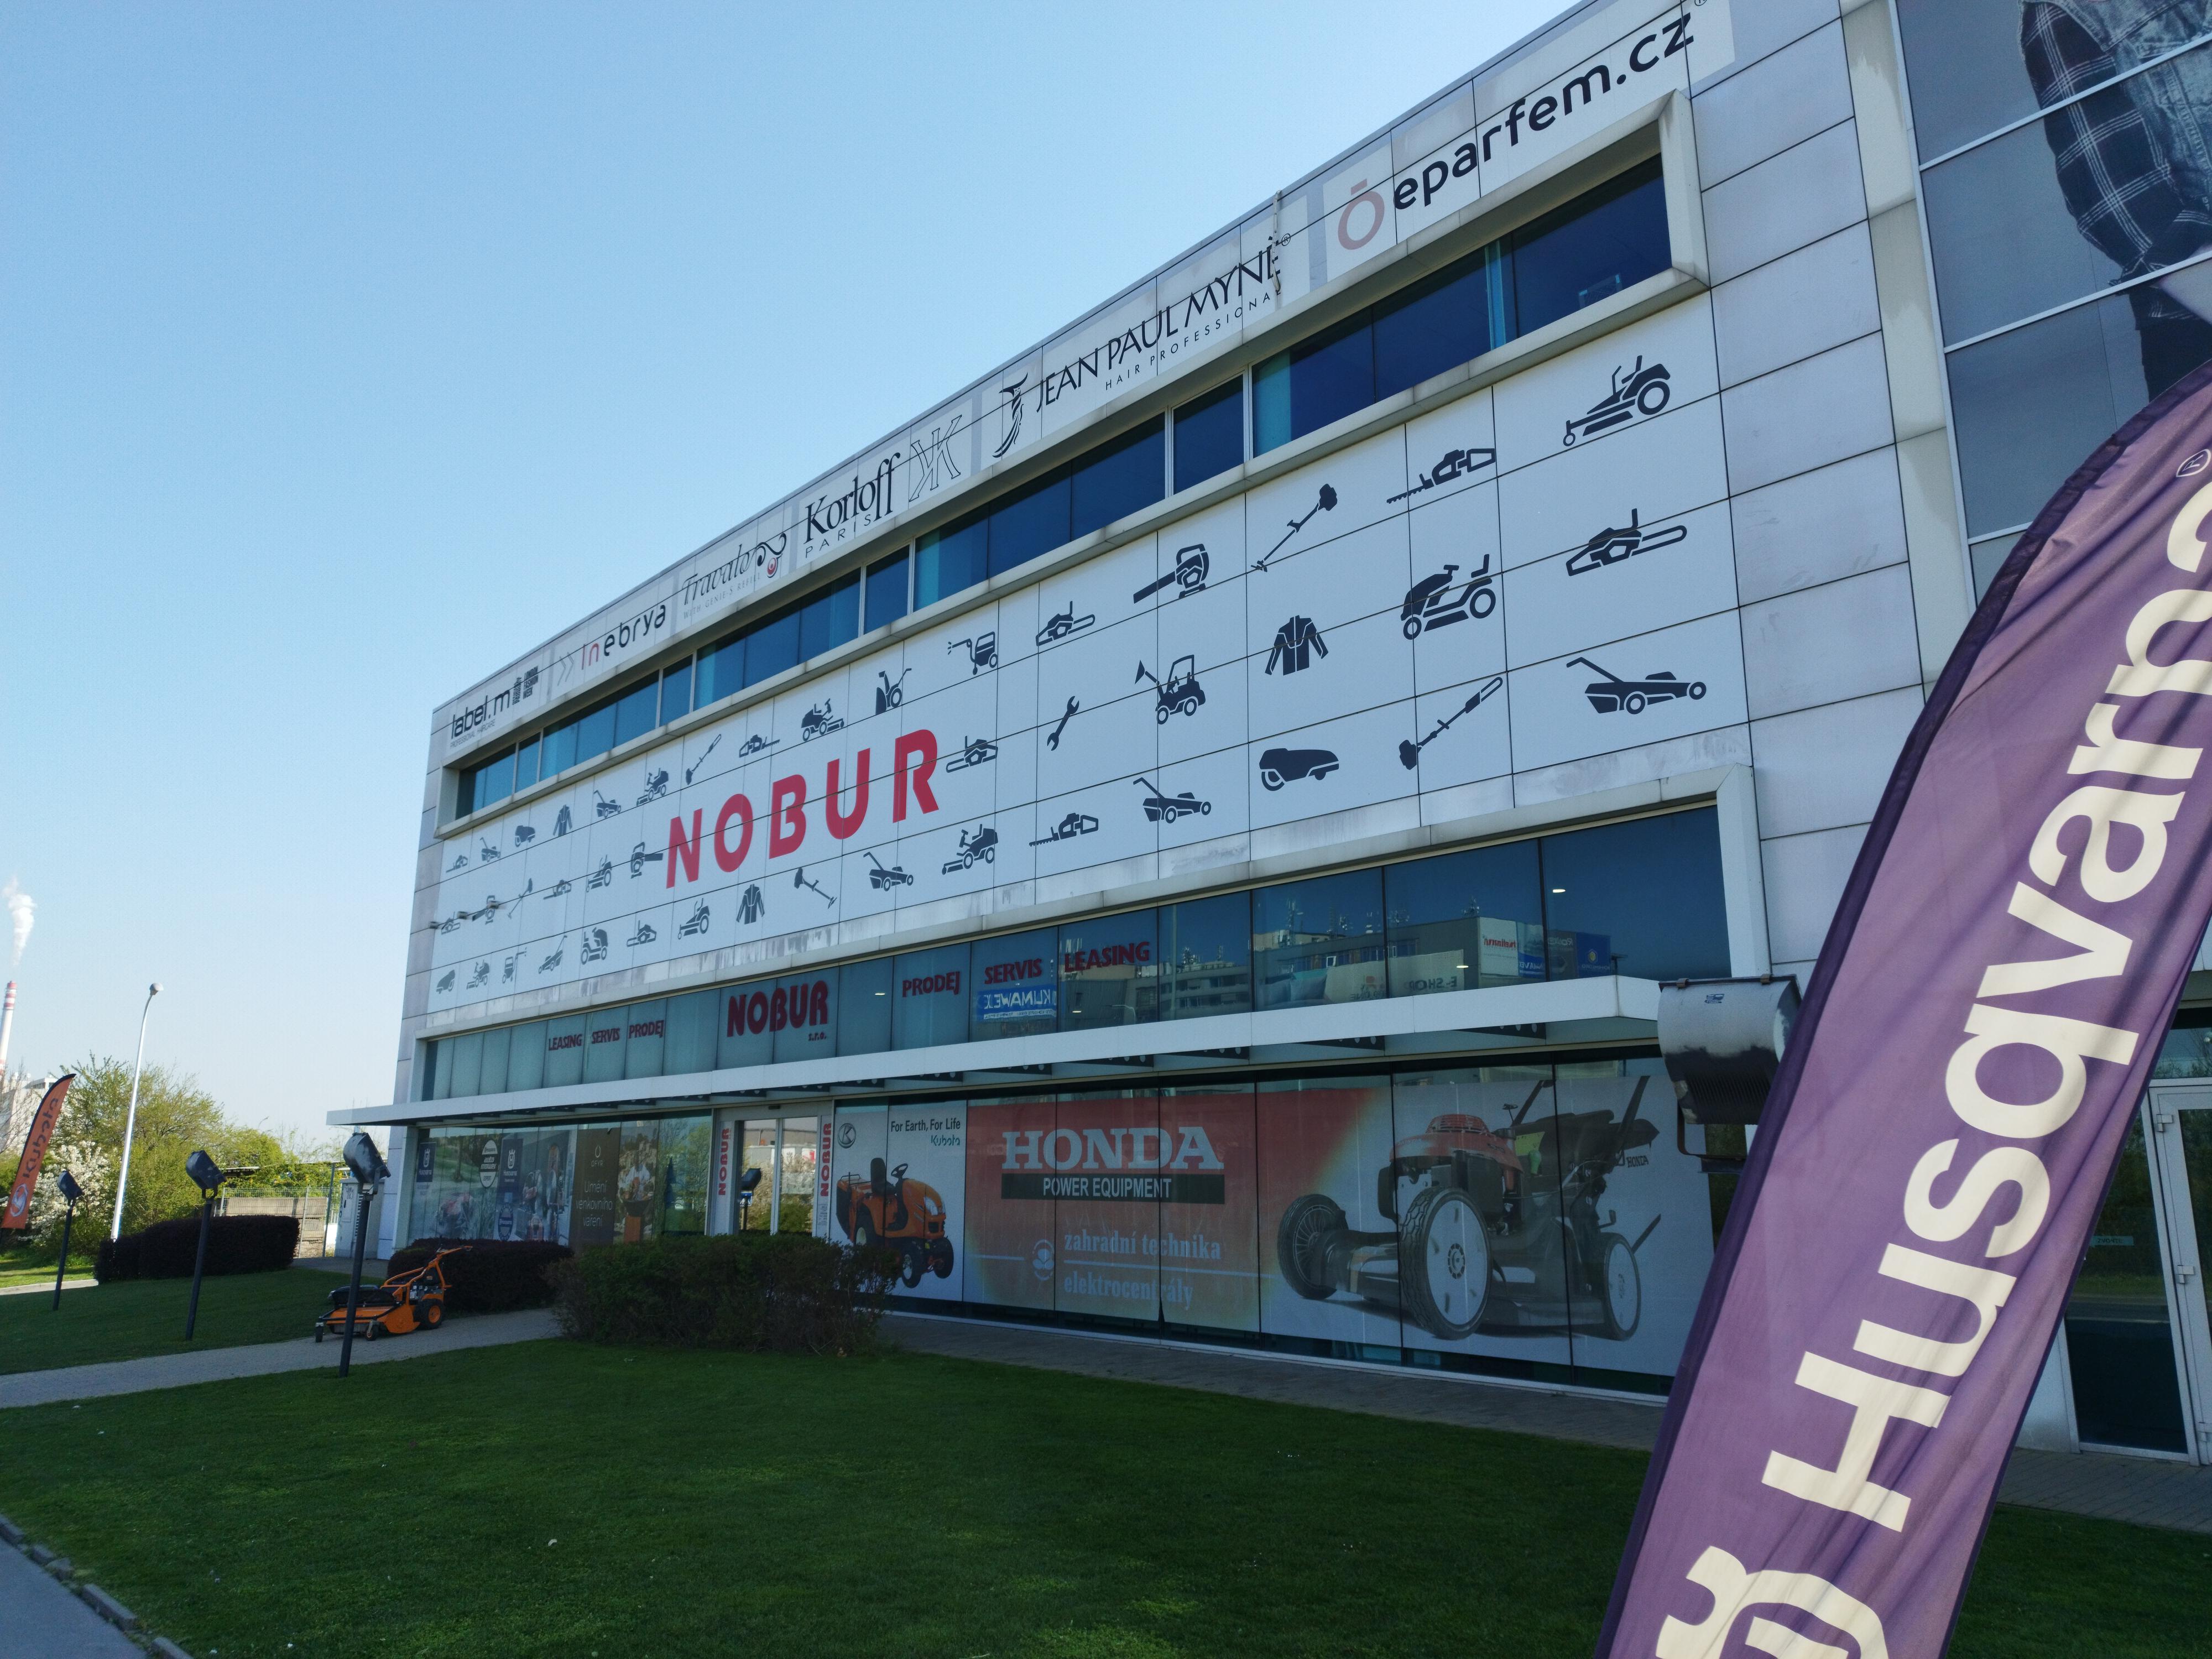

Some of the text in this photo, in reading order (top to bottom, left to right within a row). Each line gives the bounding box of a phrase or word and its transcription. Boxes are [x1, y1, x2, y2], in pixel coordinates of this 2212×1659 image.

[1393, 12, 1694, 210] eparfem.cz
[1037, 348, 1098, 413] JEAN
[1108, 306, 1179, 370] PAUL
[1105, 364, 1141, 390] HAIR
[803, 452, 901, 544] Korloff
[805, 514, 872, 559] PARIS
[451, 690, 510, 739] label.m
[666, 729, 939, 889] NOBUR
[984, 957, 1042, 985] SERVIS
[1064, 941, 1150, 973] LEASING
[902, 971, 961, 998] PRODEJ
[727, 980, 828, 1037] NOBUR
[549, 1019, 665, 1051] LEASING SERVIS PRODEJ
[891, 1118, 961, 1133] For Earth, For Life
[931, 1134, 961, 1146] Kubota
[718, 1128, 730, 1196] NOBUR
[821, 1122, 832, 1197] NOBUR
[1001, 1126, 1225, 1171] HONDA
[1626, 1154, 1649, 1168] HONDA
[576, 1197, 613, 1211] venkovního
[1043, 1177, 1172, 1199] POWER EQUIPMENT
[1064, 1228, 1222, 1260] zahradní technika
[1063, 1271, 1194, 1311] elektrocentrály
